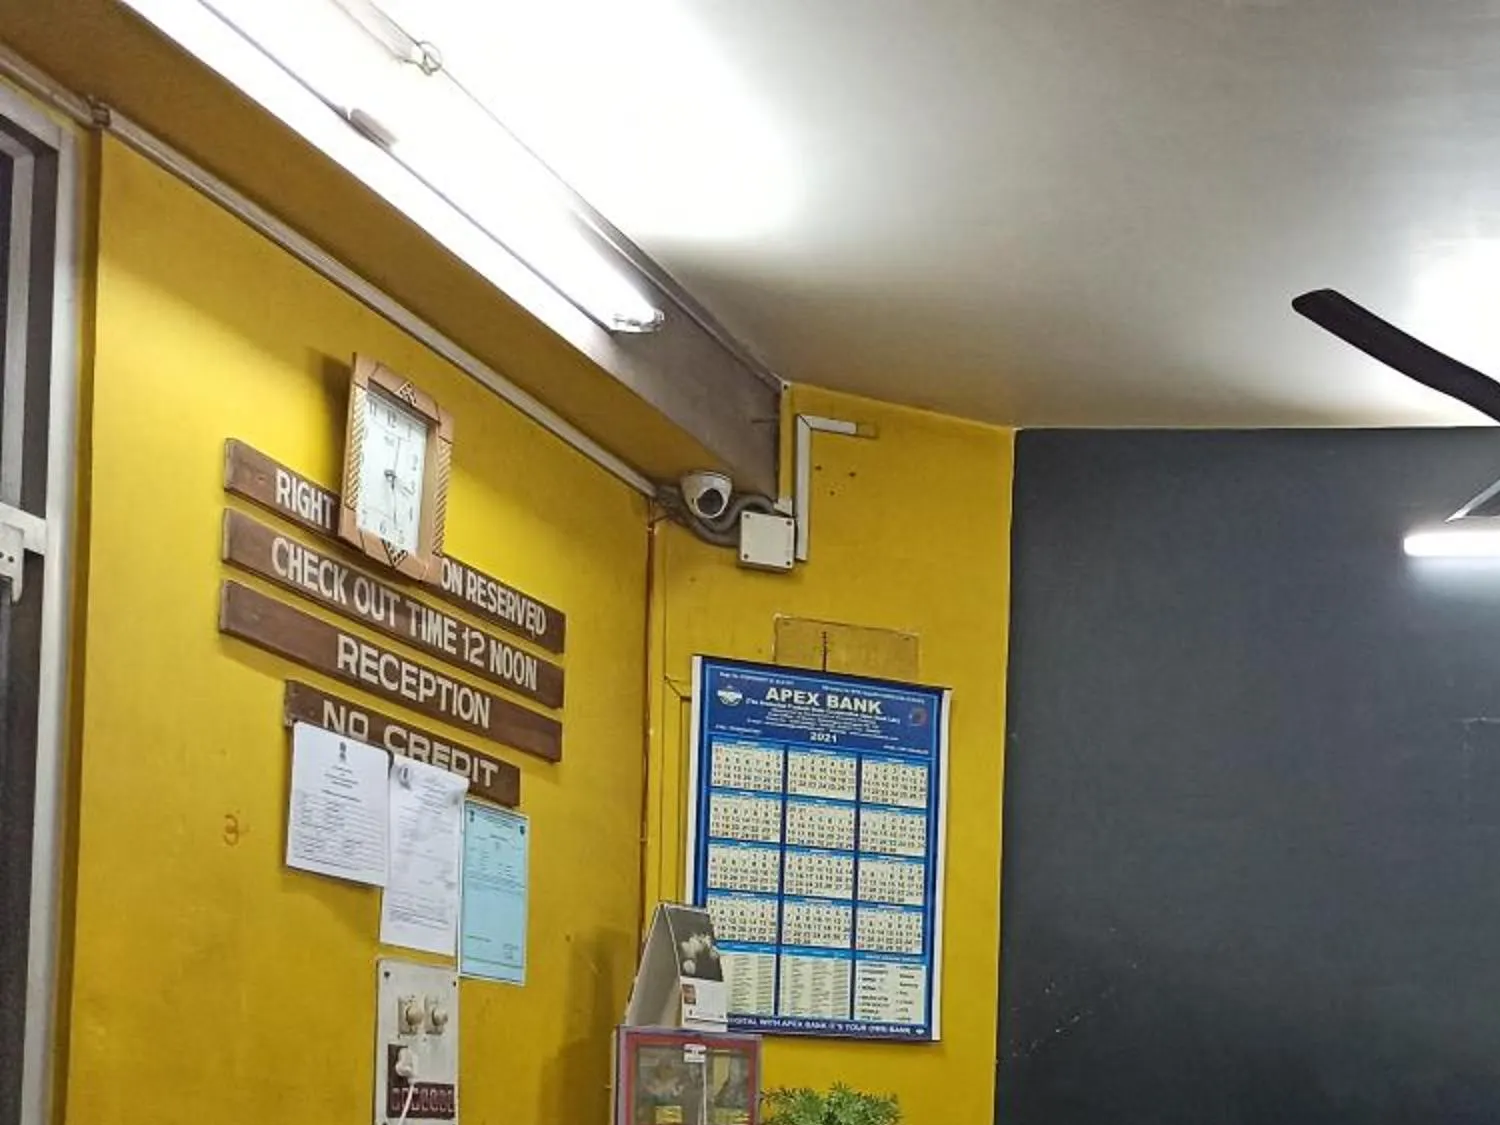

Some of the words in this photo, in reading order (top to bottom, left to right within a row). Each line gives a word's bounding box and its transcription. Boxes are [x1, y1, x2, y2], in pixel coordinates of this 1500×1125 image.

[275, 467, 335, 530] RIGHT
[465, 569, 547, 636] RESERVED
[271, 536, 349, 606] CHECK
[353, 577, 401, 629] OUT
[405, 599, 457, 656] TIME
[461, 626, 486, 667] 12
[489, 639, 537, 692] NOON
[336, 633, 492, 730] RECEPTION
[765, 686, 821, 707] APEX
[826, 691, 882, 715] BANK
[322, 700, 370, 744] NO
[383, 724, 499, 788] CREDIT
[810, 732, 838, 744] 2021
